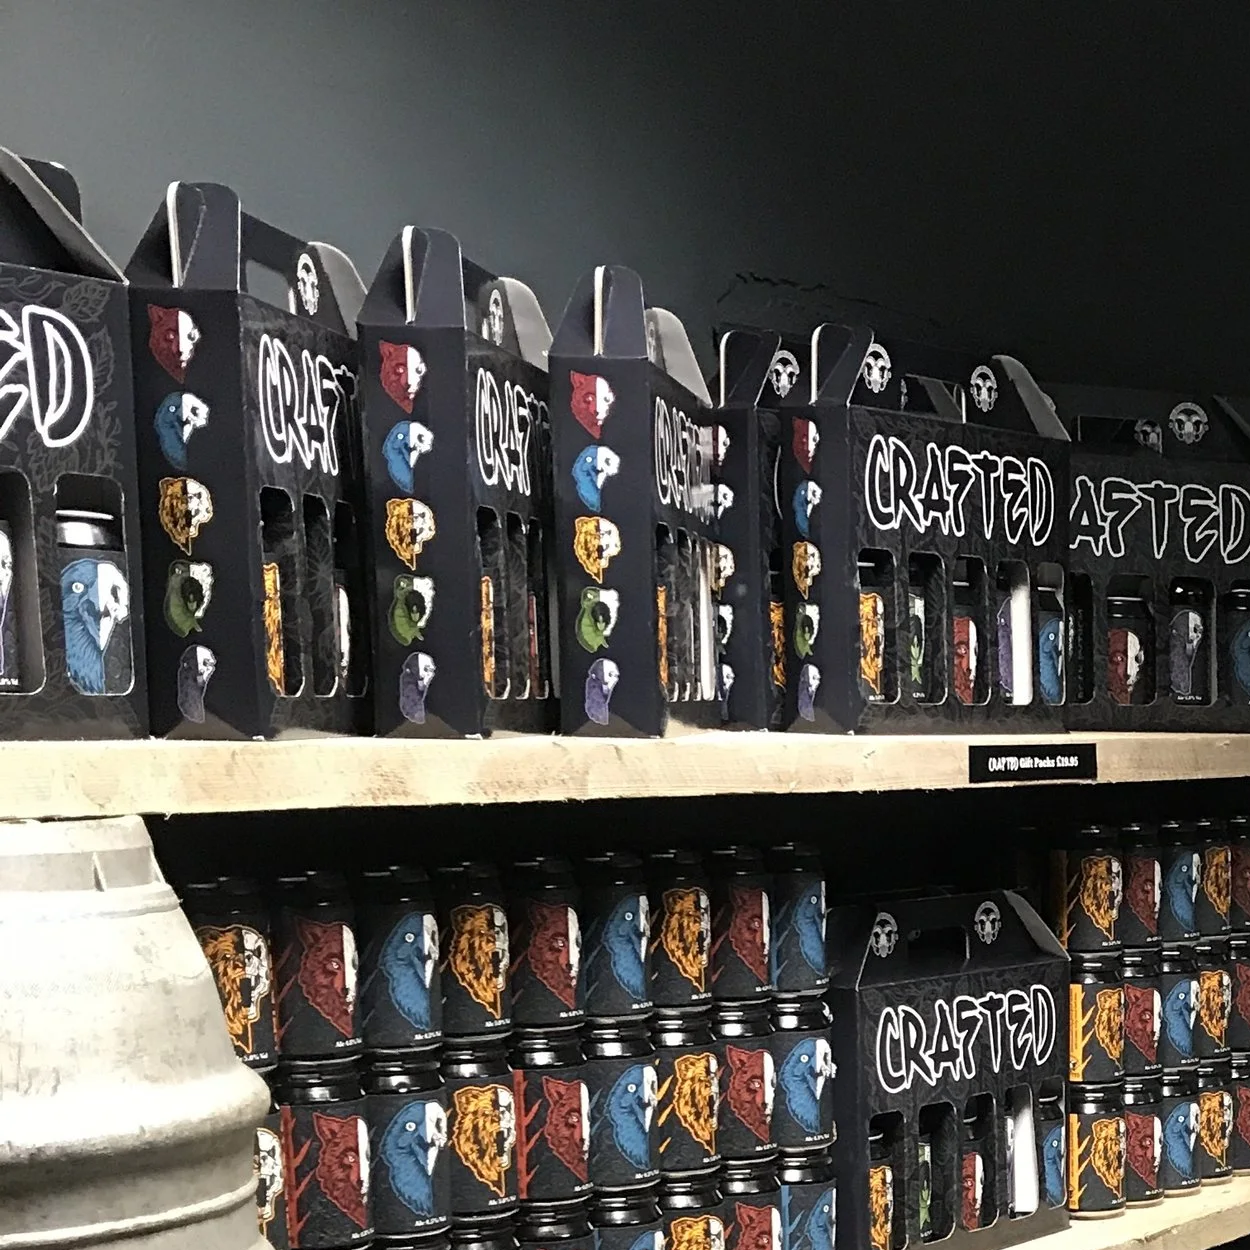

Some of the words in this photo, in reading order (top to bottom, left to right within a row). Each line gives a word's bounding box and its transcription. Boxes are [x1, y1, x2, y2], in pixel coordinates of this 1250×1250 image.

[864, 433, 1055, 547] CRAFTED
[1034, 756, 1056, 768] Packs
[876, 984, 1056, 1094] CRAFTED
